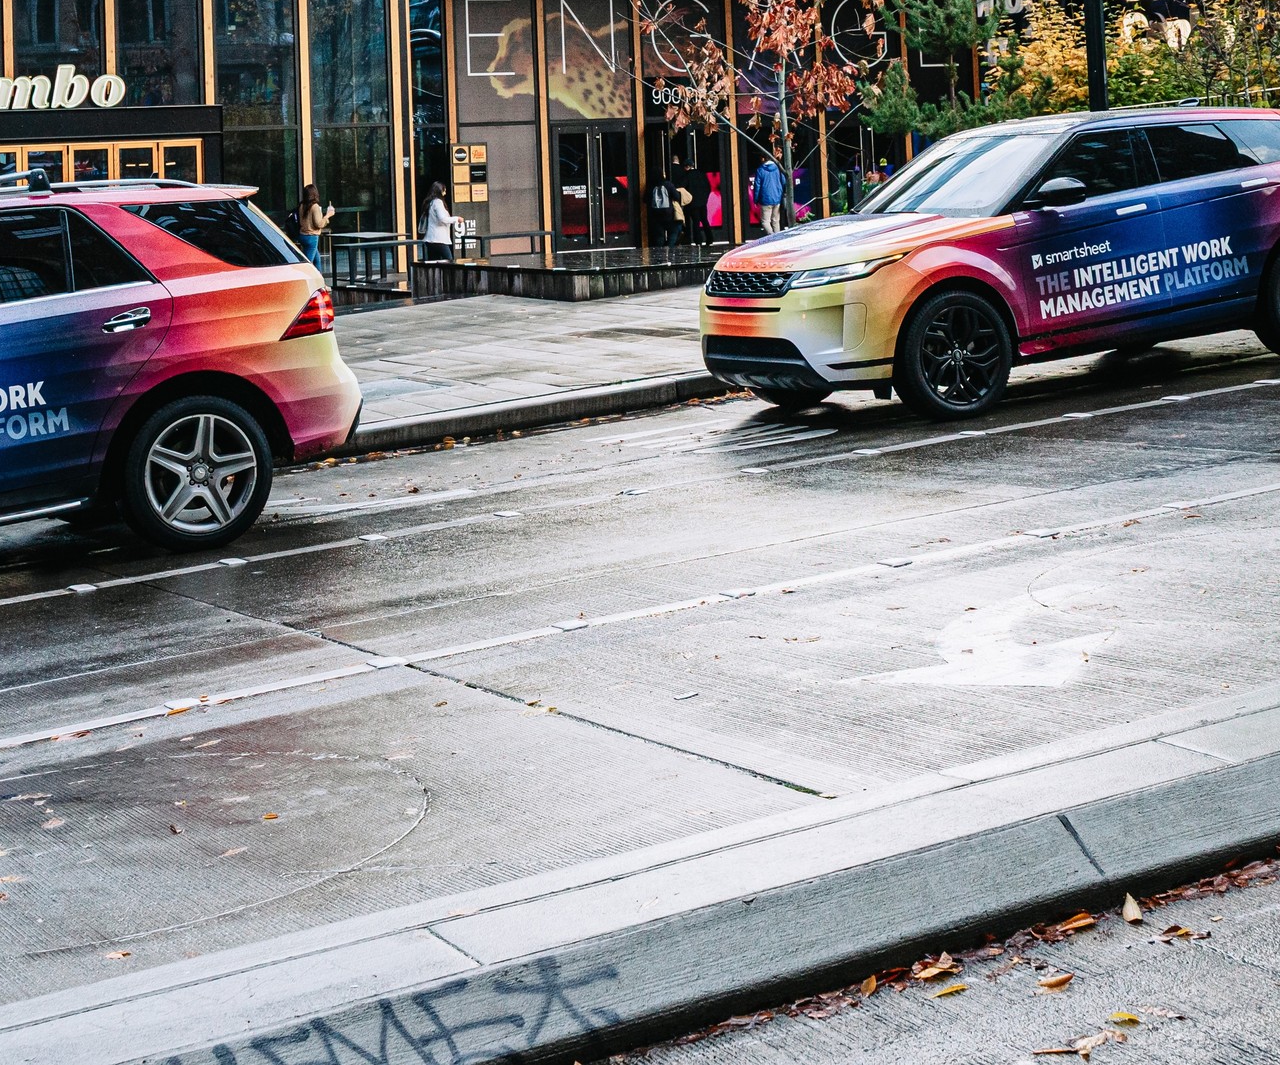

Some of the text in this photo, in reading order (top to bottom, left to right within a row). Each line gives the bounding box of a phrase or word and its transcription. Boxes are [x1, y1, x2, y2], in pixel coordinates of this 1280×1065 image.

[1036, 236, 1233, 296] THE INTELLIGENT WORK
[1045, 240, 1112, 264] smartsheet
[1039, 256, 1249, 320] MANAGEMENT PLATFORM
